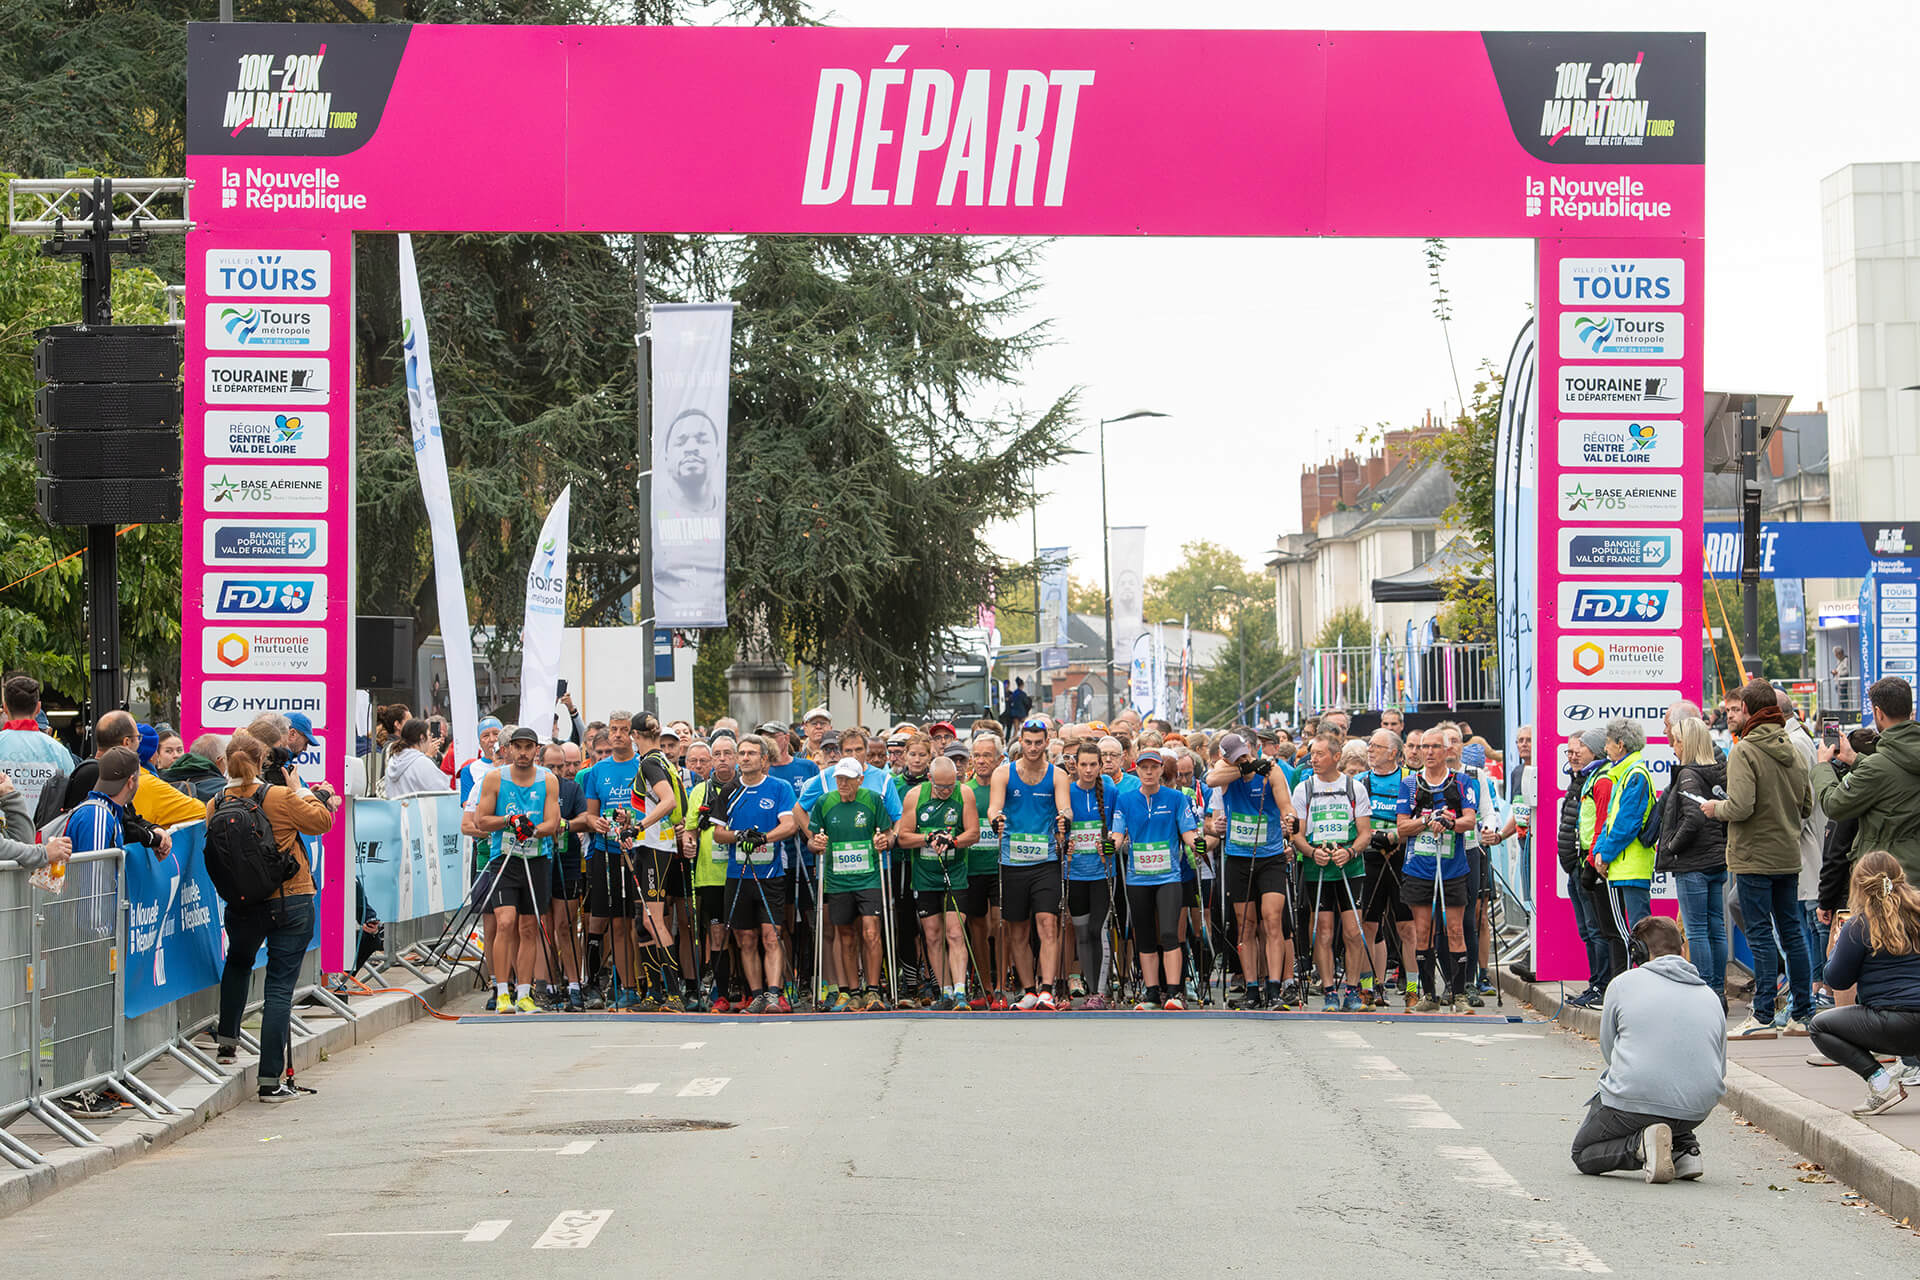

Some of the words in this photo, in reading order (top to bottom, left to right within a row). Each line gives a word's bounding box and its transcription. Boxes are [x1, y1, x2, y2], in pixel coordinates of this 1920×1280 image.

[238, 53, 325, 91] 10K-20K
[1555, 62, 1642, 99] 10K-20K
[223, 91, 331, 128] MARATHON
[329, 111, 357, 129] TOURS
[1540, 100, 1649, 136] MARATHON
[1646, 119, 1675, 137] TOURS
[801, 44, 1096, 207] DÉPART
[222, 167, 240, 188] la
[246, 168, 339, 188] Nouvelle
[1526, 176, 1545, 196] la
[1550, 176, 1644, 196] Nouvelle
[246, 188, 367, 213] République
[1550, 196, 1671, 221] République
[219, 257, 241, 265] VILLE
[244, 257, 254, 265] DE
[219, 267, 317, 291] TOURS
[1573, 276, 1671, 299] TOURS
[261, 309, 311, 325] Tours
[1614, 317, 1665, 333] Tours
[262, 326, 311, 336] métropole
[1616, 335, 1665, 344] métropole
[212, 369, 288, 383] TOURAINE
[212, 385, 222, 393] LE
[224, 382, 288, 393] DÉPARTEMENT
[1565, 378, 1642, 392] TOURAINE
[1566, 394, 1575, 402] LE
[1578, 391, 1642, 402] DÉPARTEMENT
[229, 422, 271, 434] RÉGION
[229, 435, 271, 444] CENTRE
[1583, 431, 1625, 442] RÉGION
[230, 444, 249, 454] VAL
[251, 445, 265, 454] DE
[267, 445, 296, 454] LOIRE
[1583, 443, 1625, 453] CENTRE
[1584, 453, 1603, 463] VAL
[1605, 453, 1618, 463] DE
[1621, 453, 1650, 463] LOIRE
[241, 480, 267, 489] BASE
[270, 478, 322, 490] AÉRIENNE
[241, 489, 272, 501] 705
[1595, 488, 1622, 498] BASE
[1625, 486, 1677, 498] AÉRIENNE
[1595, 498, 1626, 510] 705
[250, 532, 286, 540] BANQUE
[1604, 540, 1641, 548] BANQUE
[221, 546, 237, 554] VAL
[252, 547, 286, 555] FRANCE
[1592, 547, 1641, 555] POPULAIRE
[1576, 555, 1593, 563] VAL
[222, 585, 278, 609] FDJ
[1577, 594, 1633, 617] FDJ
[254, 634, 309, 645] Harmonie
[254, 644, 309, 654] mutuelle
[1609, 643, 1665, 653] Harmonie
[1609, 652, 1665, 662] mutuelle
[243, 698, 321, 711] HYUNDAI
[1599, 706, 1668, 719] HYUNDA
[14, 768, 52, 778] COURS
[1236, 825, 1258, 836] 537
[1318, 823, 1343, 833] 5183
[981, 830, 999, 840] 08
[1016, 845, 1041, 856] 5372
[838, 853, 862, 864] 5086
[1139, 854, 1164, 864] 5373
